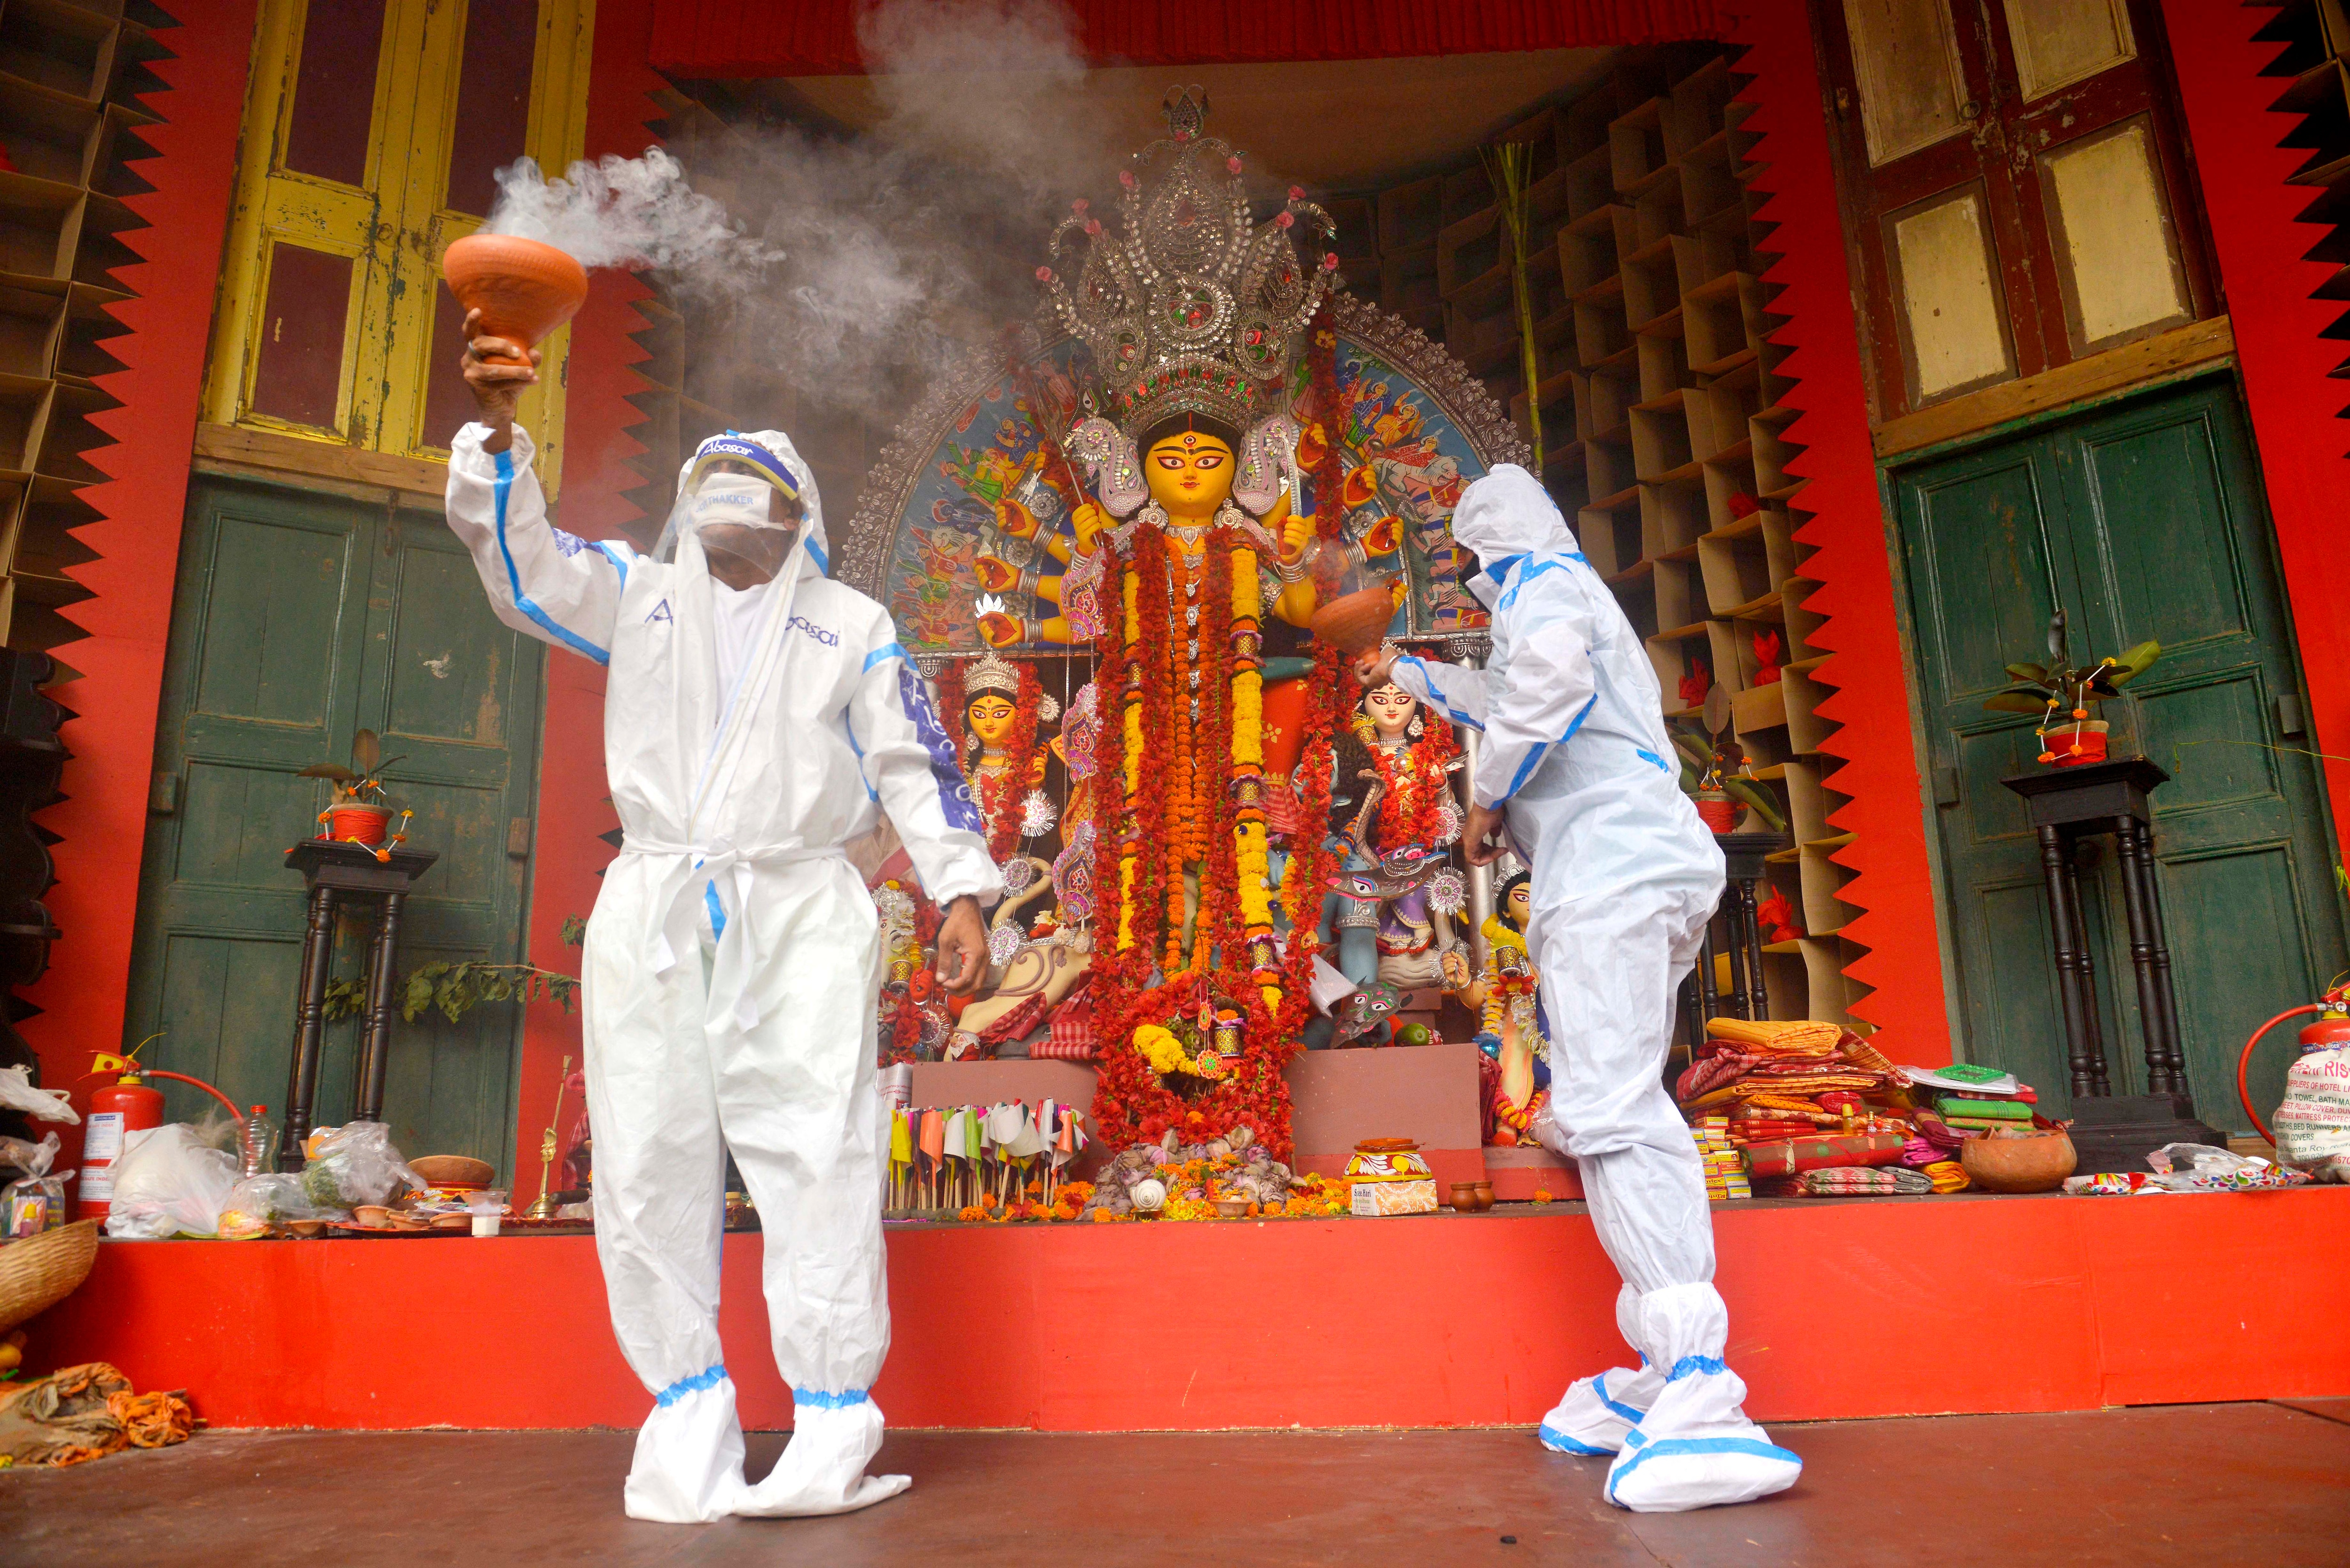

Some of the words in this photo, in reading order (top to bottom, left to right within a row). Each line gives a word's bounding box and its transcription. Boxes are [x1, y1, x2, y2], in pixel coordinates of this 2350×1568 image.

[701, 440, 753, 457] Abasar
[708, 494, 753, 505] THAKKER
[2325, 1061, 2350, 1078] RIS
[2320, 1083, 2341, 1092] HOTEL
[2319, 1095, 2336, 1104] BATH
[2338, 1098, 2350, 1107] MA
[2295, 1113, 2321, 1121] MATTRESS
[1363, 1189, 1371, 1197] Hari
